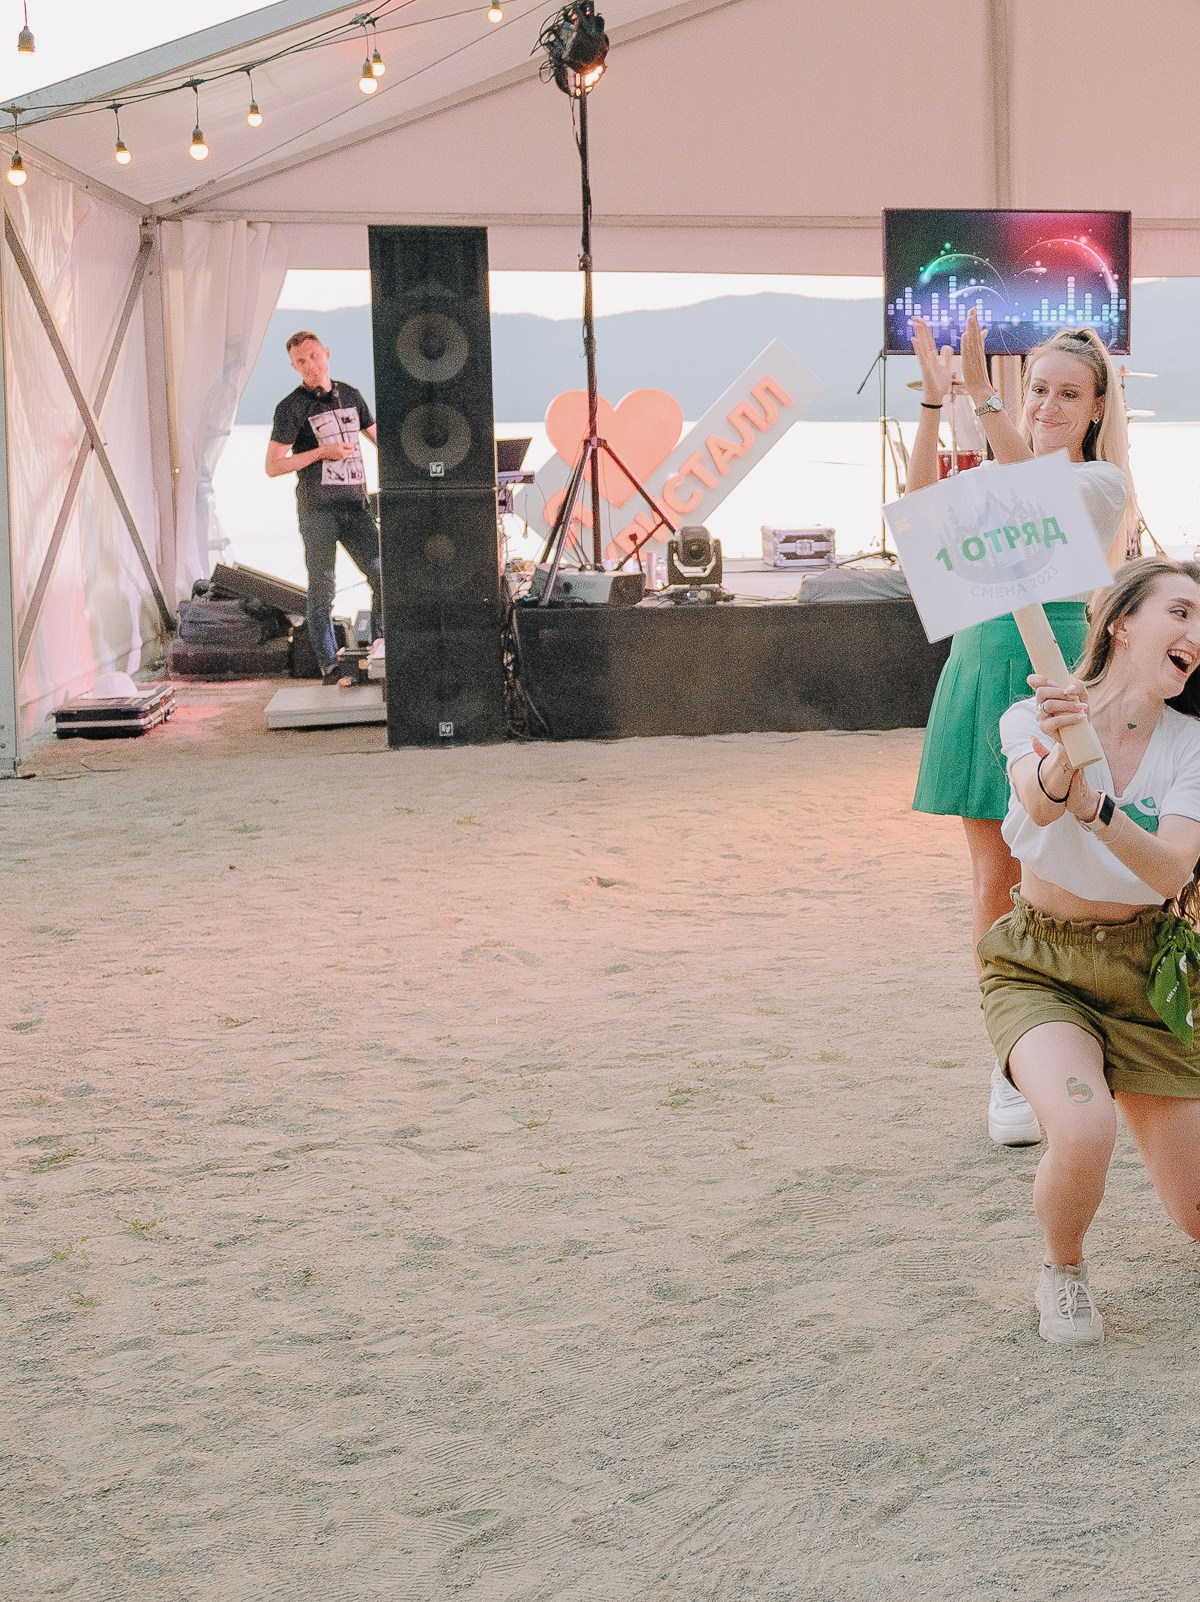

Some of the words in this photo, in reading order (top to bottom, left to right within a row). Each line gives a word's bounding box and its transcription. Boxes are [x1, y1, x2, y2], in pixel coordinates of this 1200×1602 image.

[606, 374, 794, 563] РИСТАЛЛ
[934, 547, 954, 572] 1
[961, 516, 1068, 562] ОТРЯД
[971, 582, 1028, 598] СМЕНА
[1031, 566, 1058, 590] 2023
